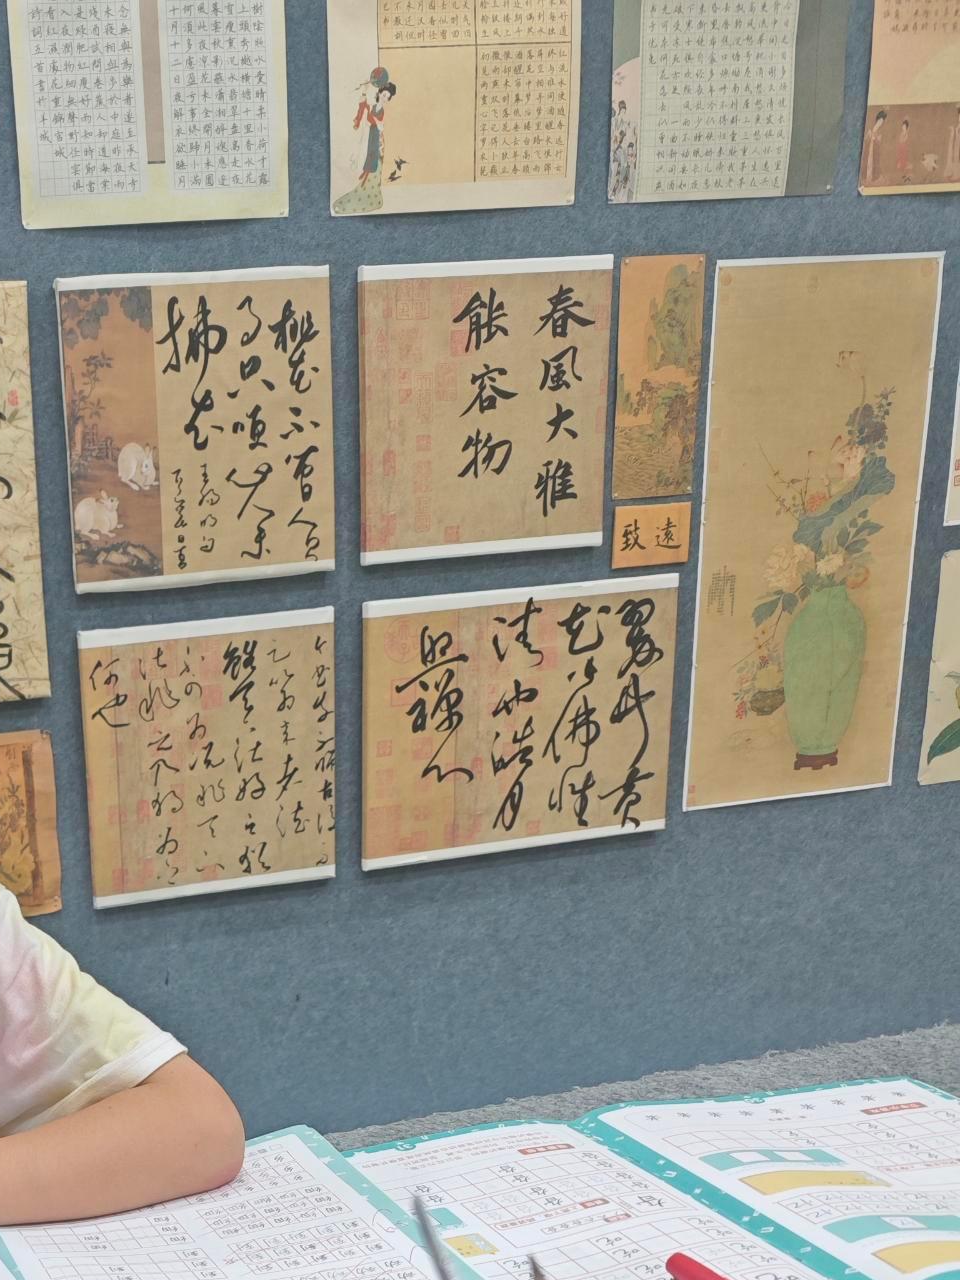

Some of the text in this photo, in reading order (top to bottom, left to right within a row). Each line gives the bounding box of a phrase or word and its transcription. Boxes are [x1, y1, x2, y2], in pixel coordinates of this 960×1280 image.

[452, 287, 519, 480] 能容物
[535, 284, 596, 518] 春風大雅
[619, 517, 681, 552] 致遠
